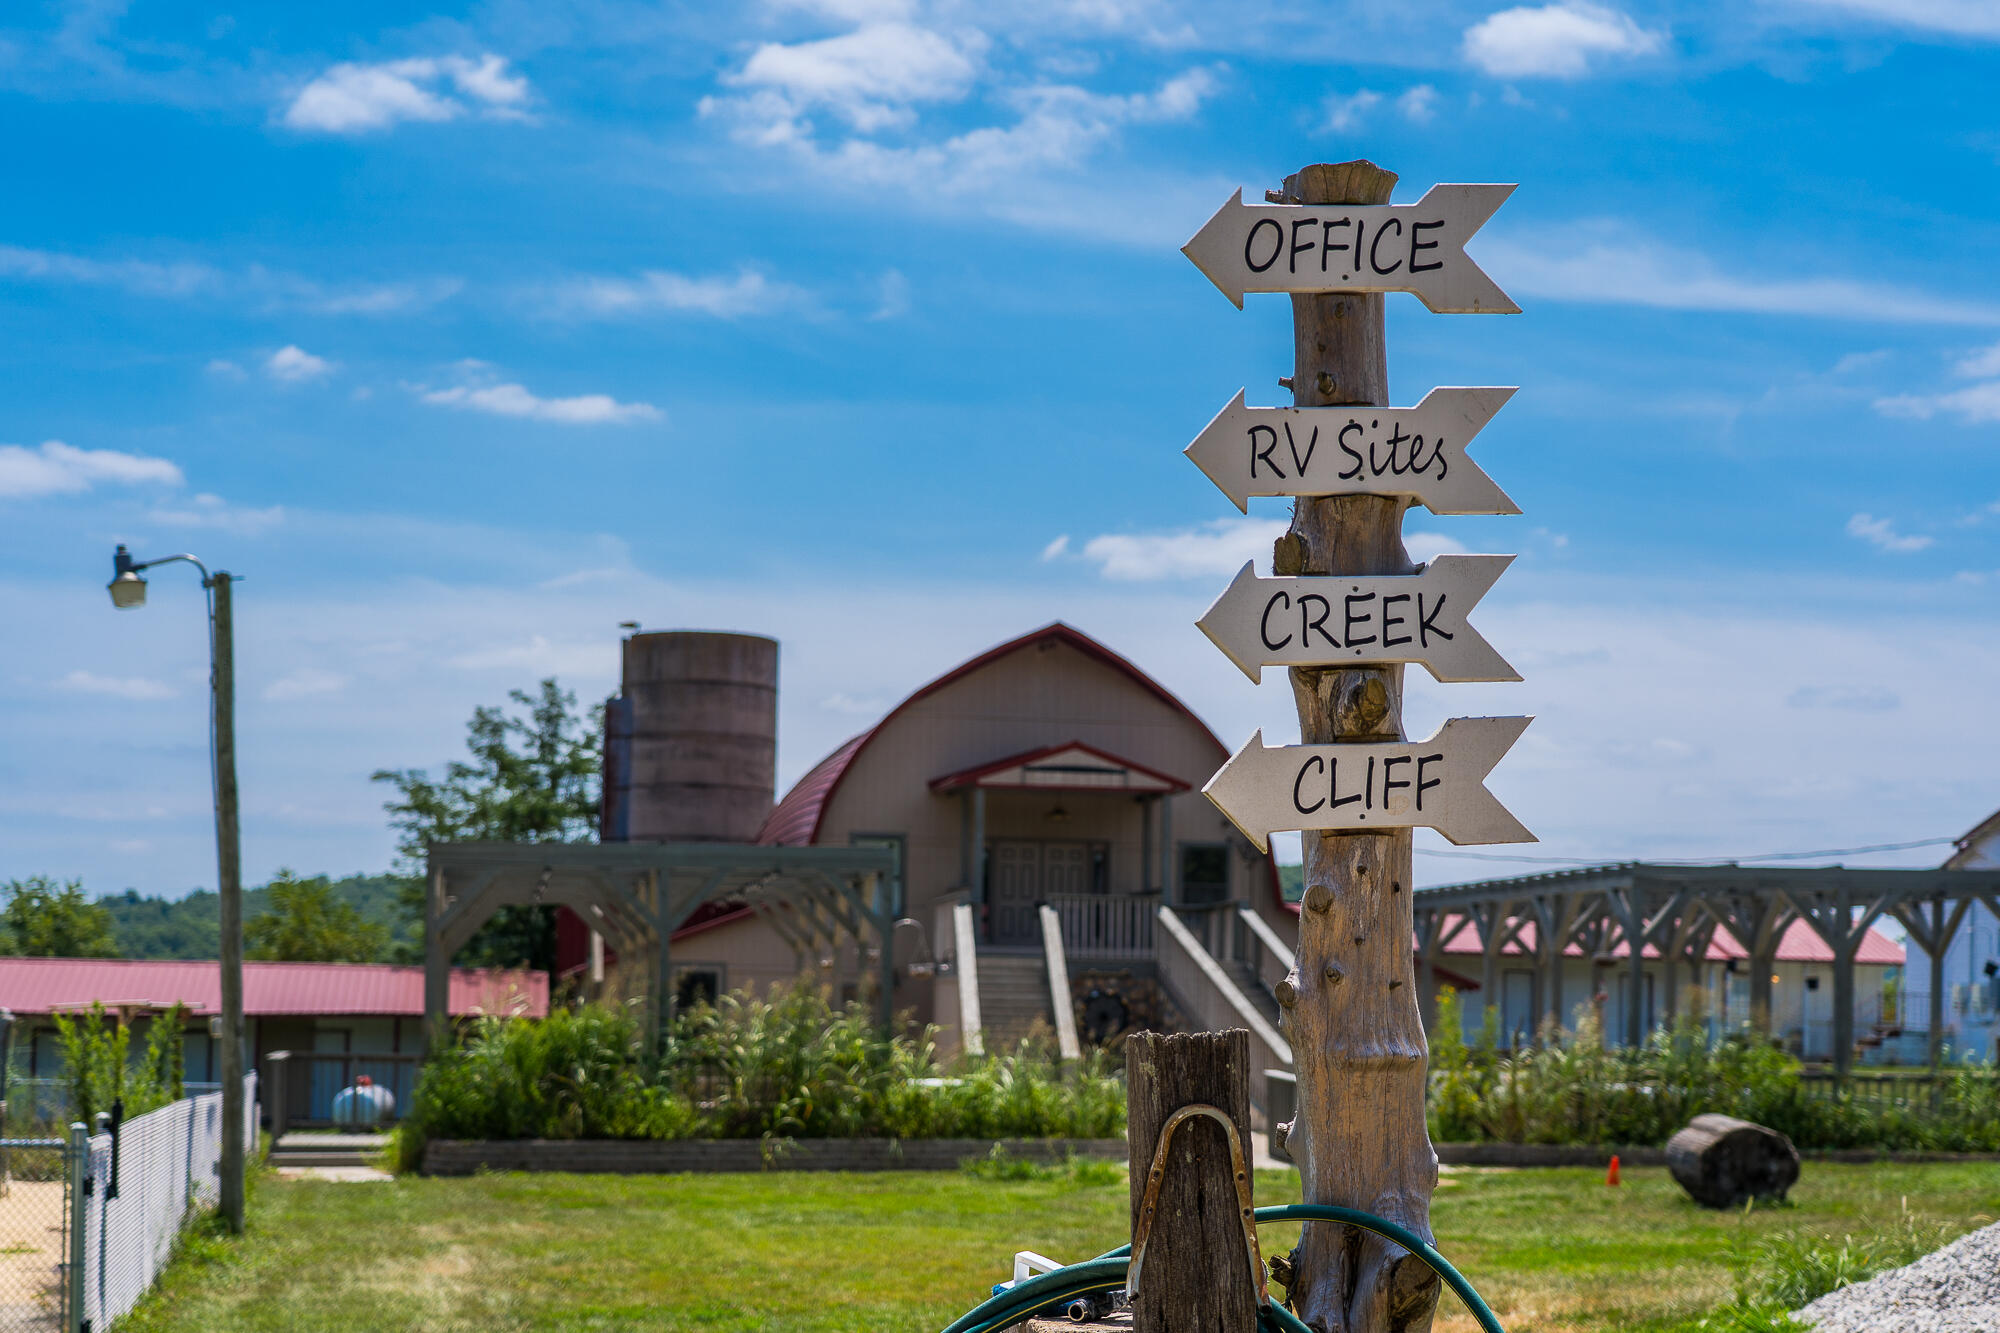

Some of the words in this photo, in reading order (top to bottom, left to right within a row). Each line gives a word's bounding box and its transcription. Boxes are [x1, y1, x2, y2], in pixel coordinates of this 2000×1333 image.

[1244, 217, 1445, 275] OFFICE
[1247, 422, 1318, 479] RV
[1338, 420, 1447, 480] Sites
[1260, 591, 1454, 651] CREEK
[1293, 753, 1444, 814] CLIFF
